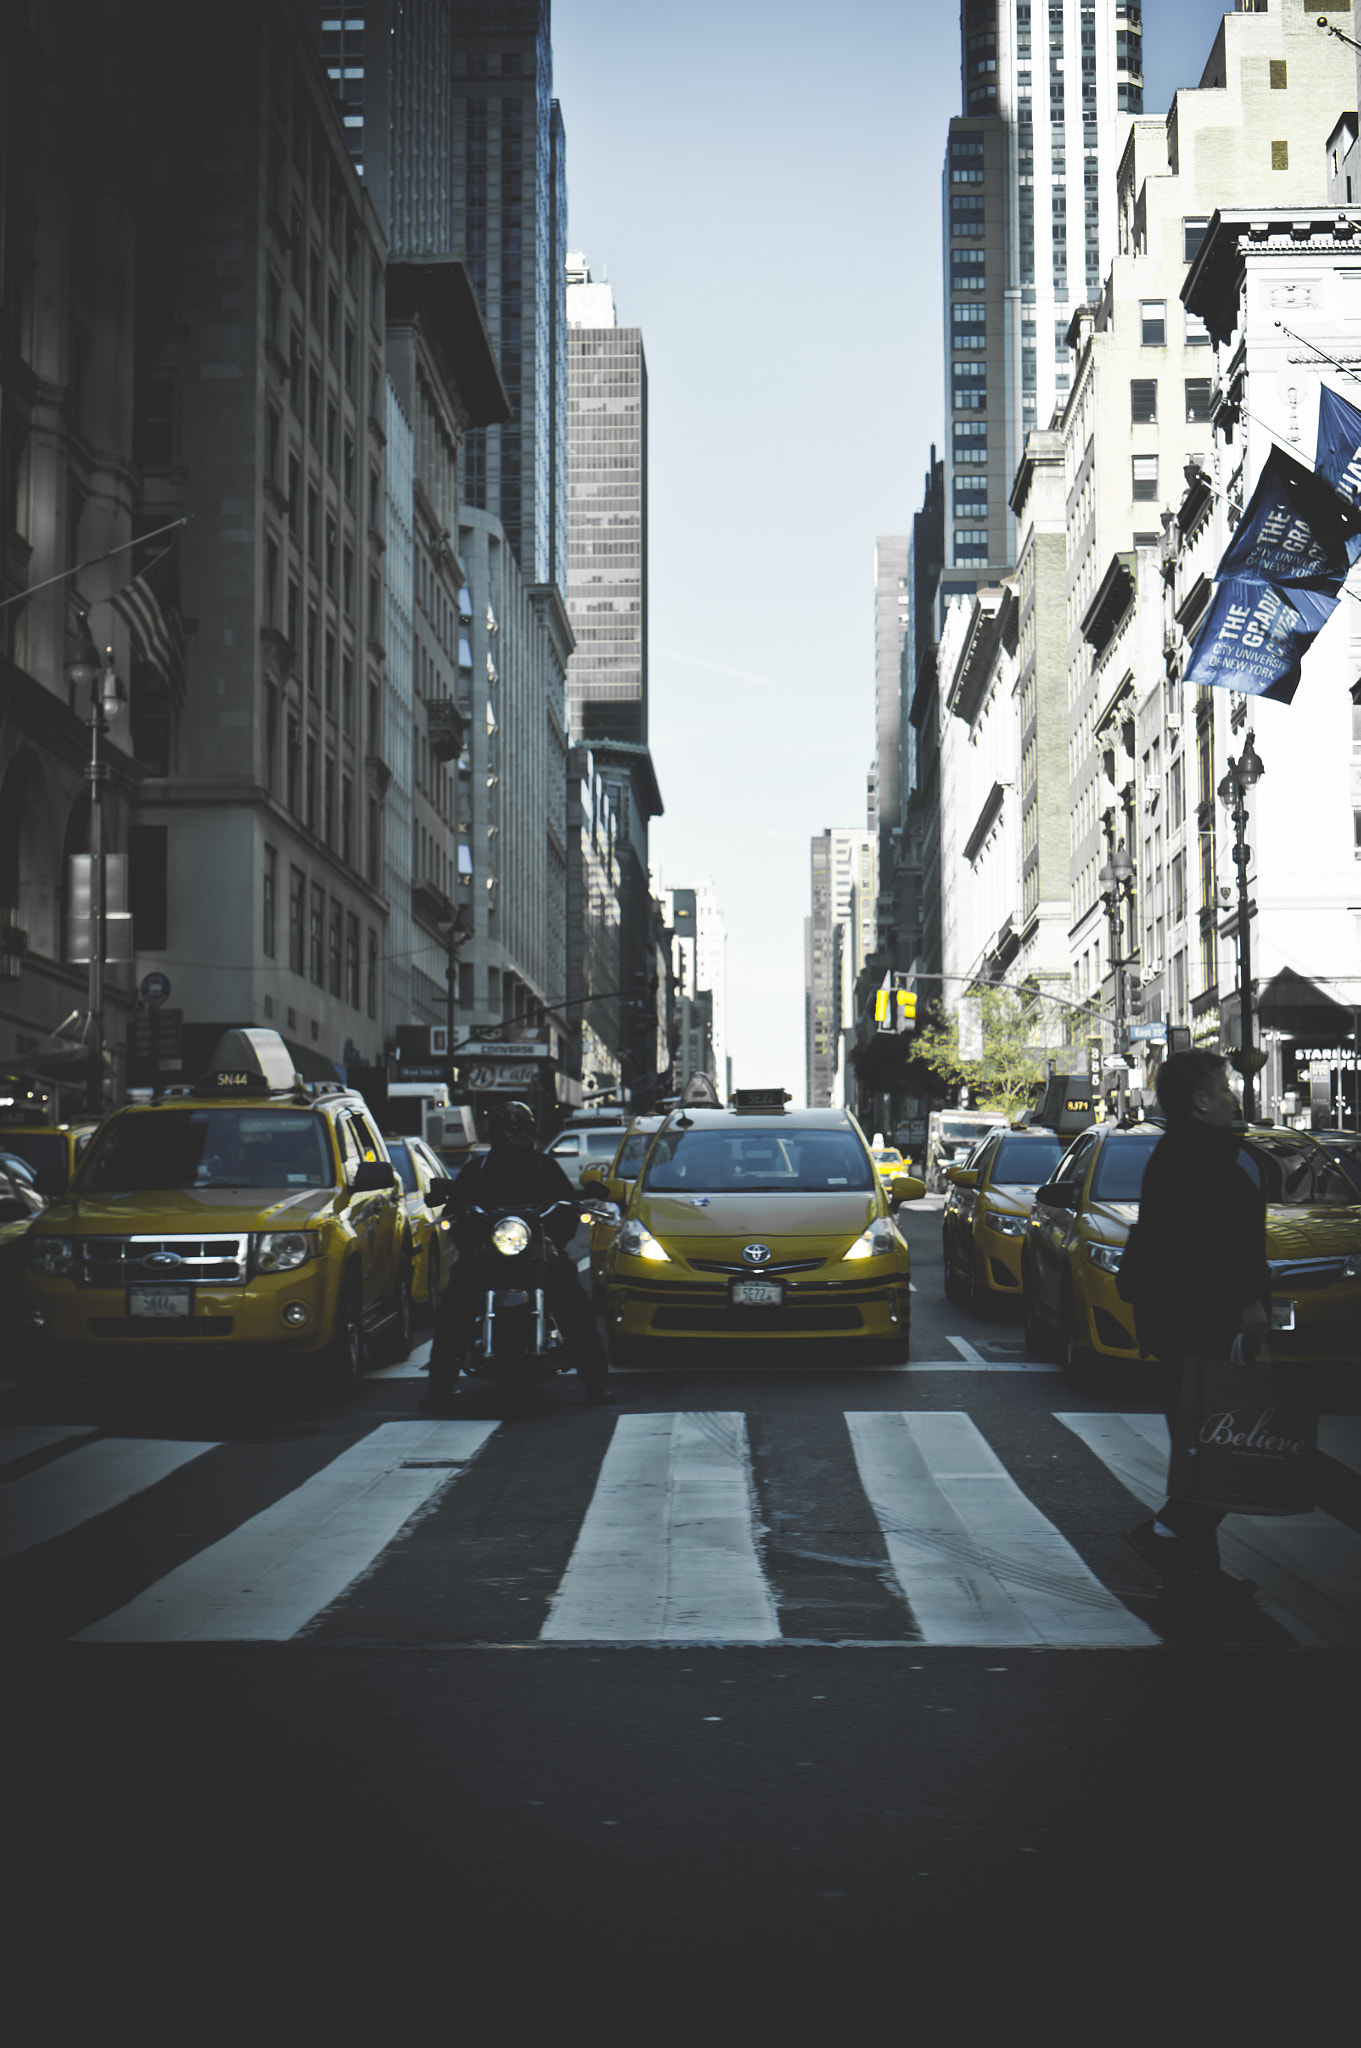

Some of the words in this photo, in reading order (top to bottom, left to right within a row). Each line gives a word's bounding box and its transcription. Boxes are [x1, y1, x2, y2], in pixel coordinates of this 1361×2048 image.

[1257, 510, 1291, 543] THE
[1218, 604, 1250, 640] THE
[1213, 643, 1235, 656] CITY
[1209, 656, 1222, 667] OF
[1222, 658, 1248, 671] NEW
[1249, 663, 1276, 680] YORK
[481, 1045, 534, 1054] CONVERSE
[217, 1073, 248, 1086] 5N44
[1200, 1407, 1305, 1454] Believe
